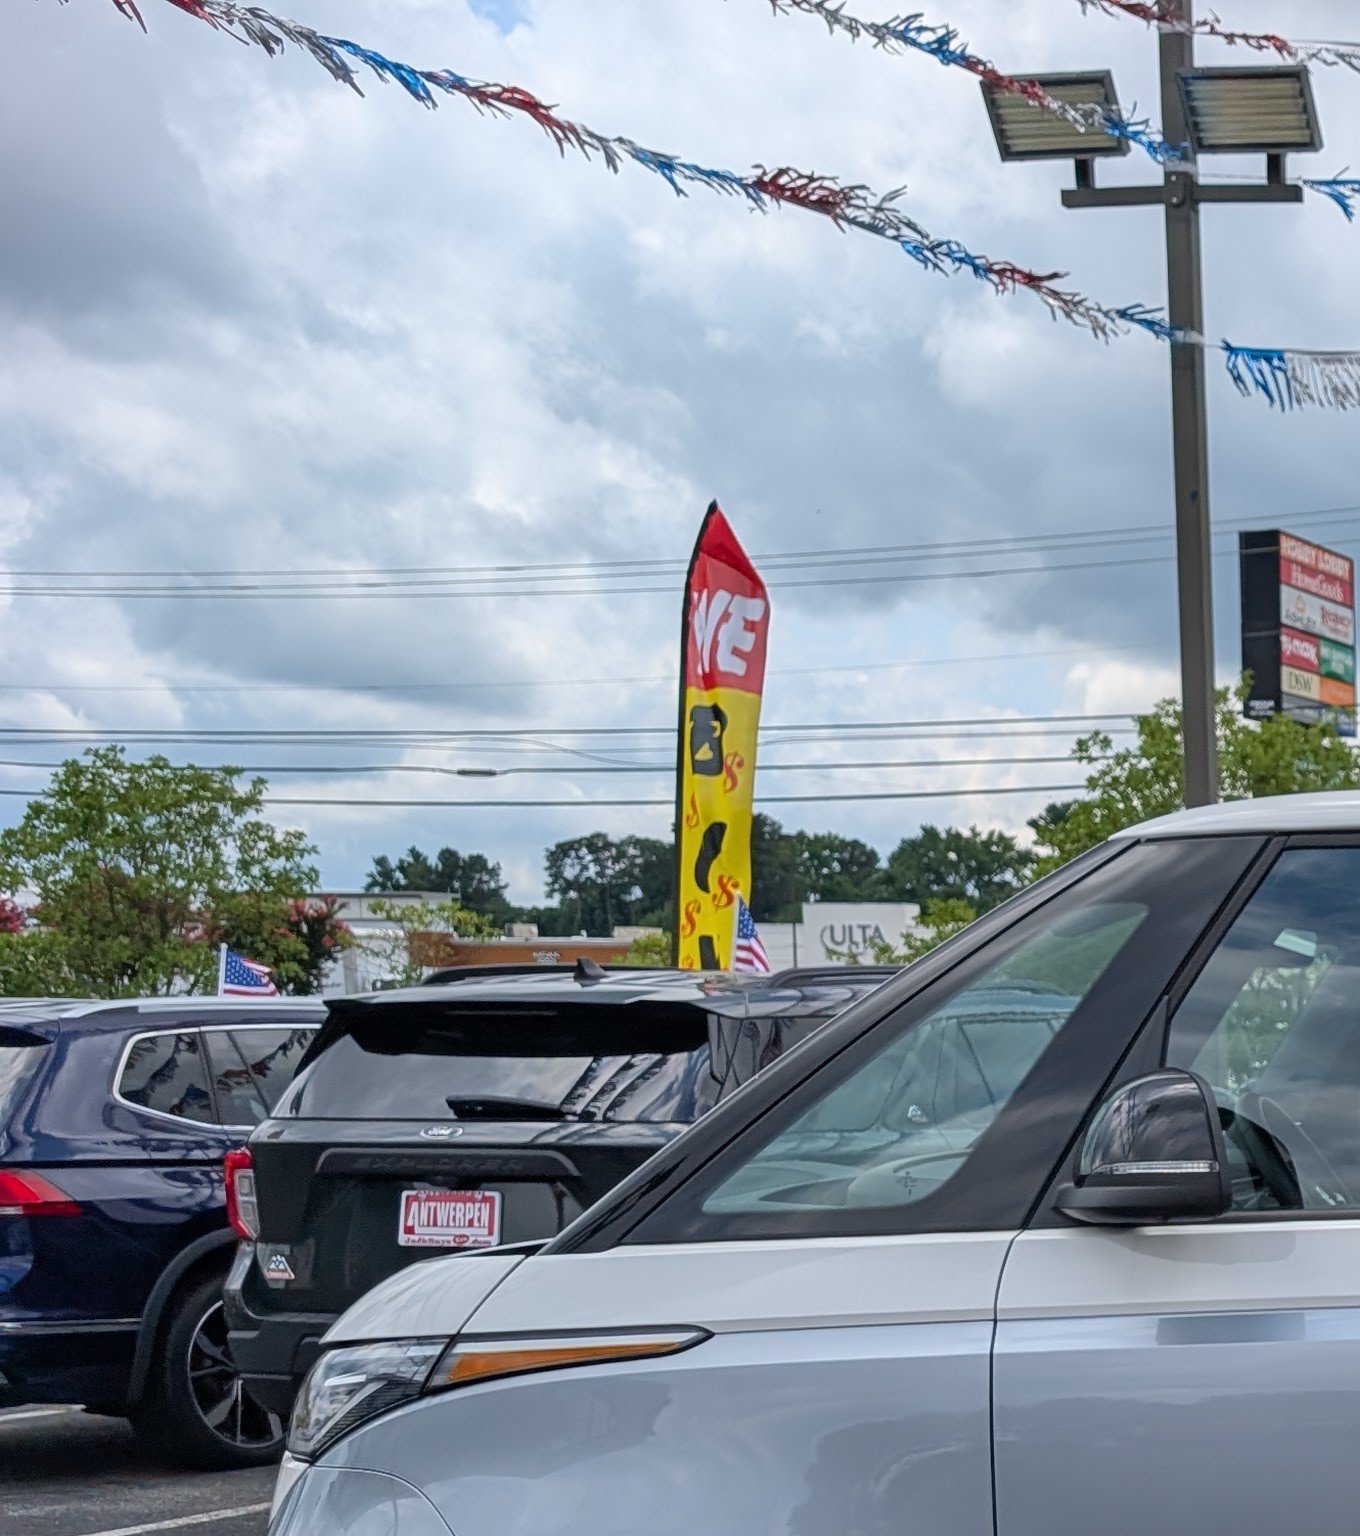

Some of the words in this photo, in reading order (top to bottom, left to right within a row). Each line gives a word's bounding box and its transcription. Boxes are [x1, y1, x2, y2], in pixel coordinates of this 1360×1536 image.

[693, 588, 766, 677] WE
[828, 923, 887, 948] ULTA
[406, 1201, 490, 1228] ANTWERPEN
